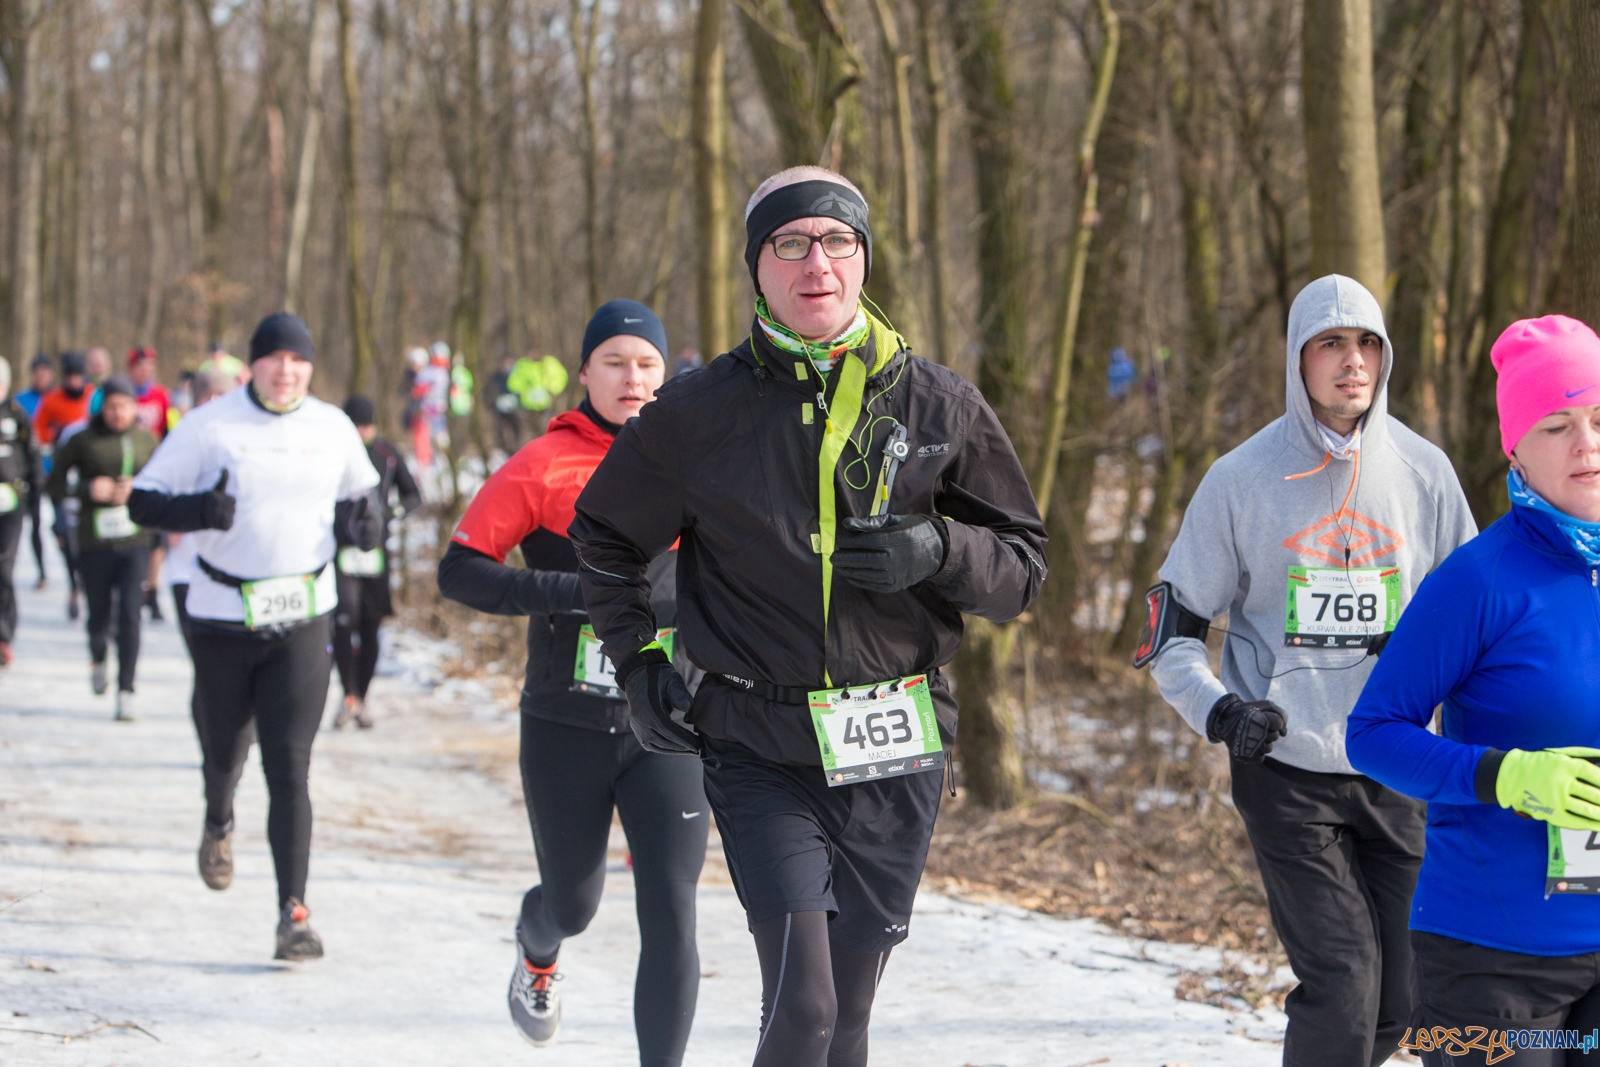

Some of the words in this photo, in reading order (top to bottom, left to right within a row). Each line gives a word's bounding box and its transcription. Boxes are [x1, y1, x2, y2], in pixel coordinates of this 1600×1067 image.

[260, 591, 302, 615] 296
[1311, 592, 1377, 622] 768
[1307, 625, 1336, 633] KURWA
[1338, 625, 1353, 634] ALE
[842, 708, 913, 750] 463
[867, 748, 897, 762] MACIEJ
